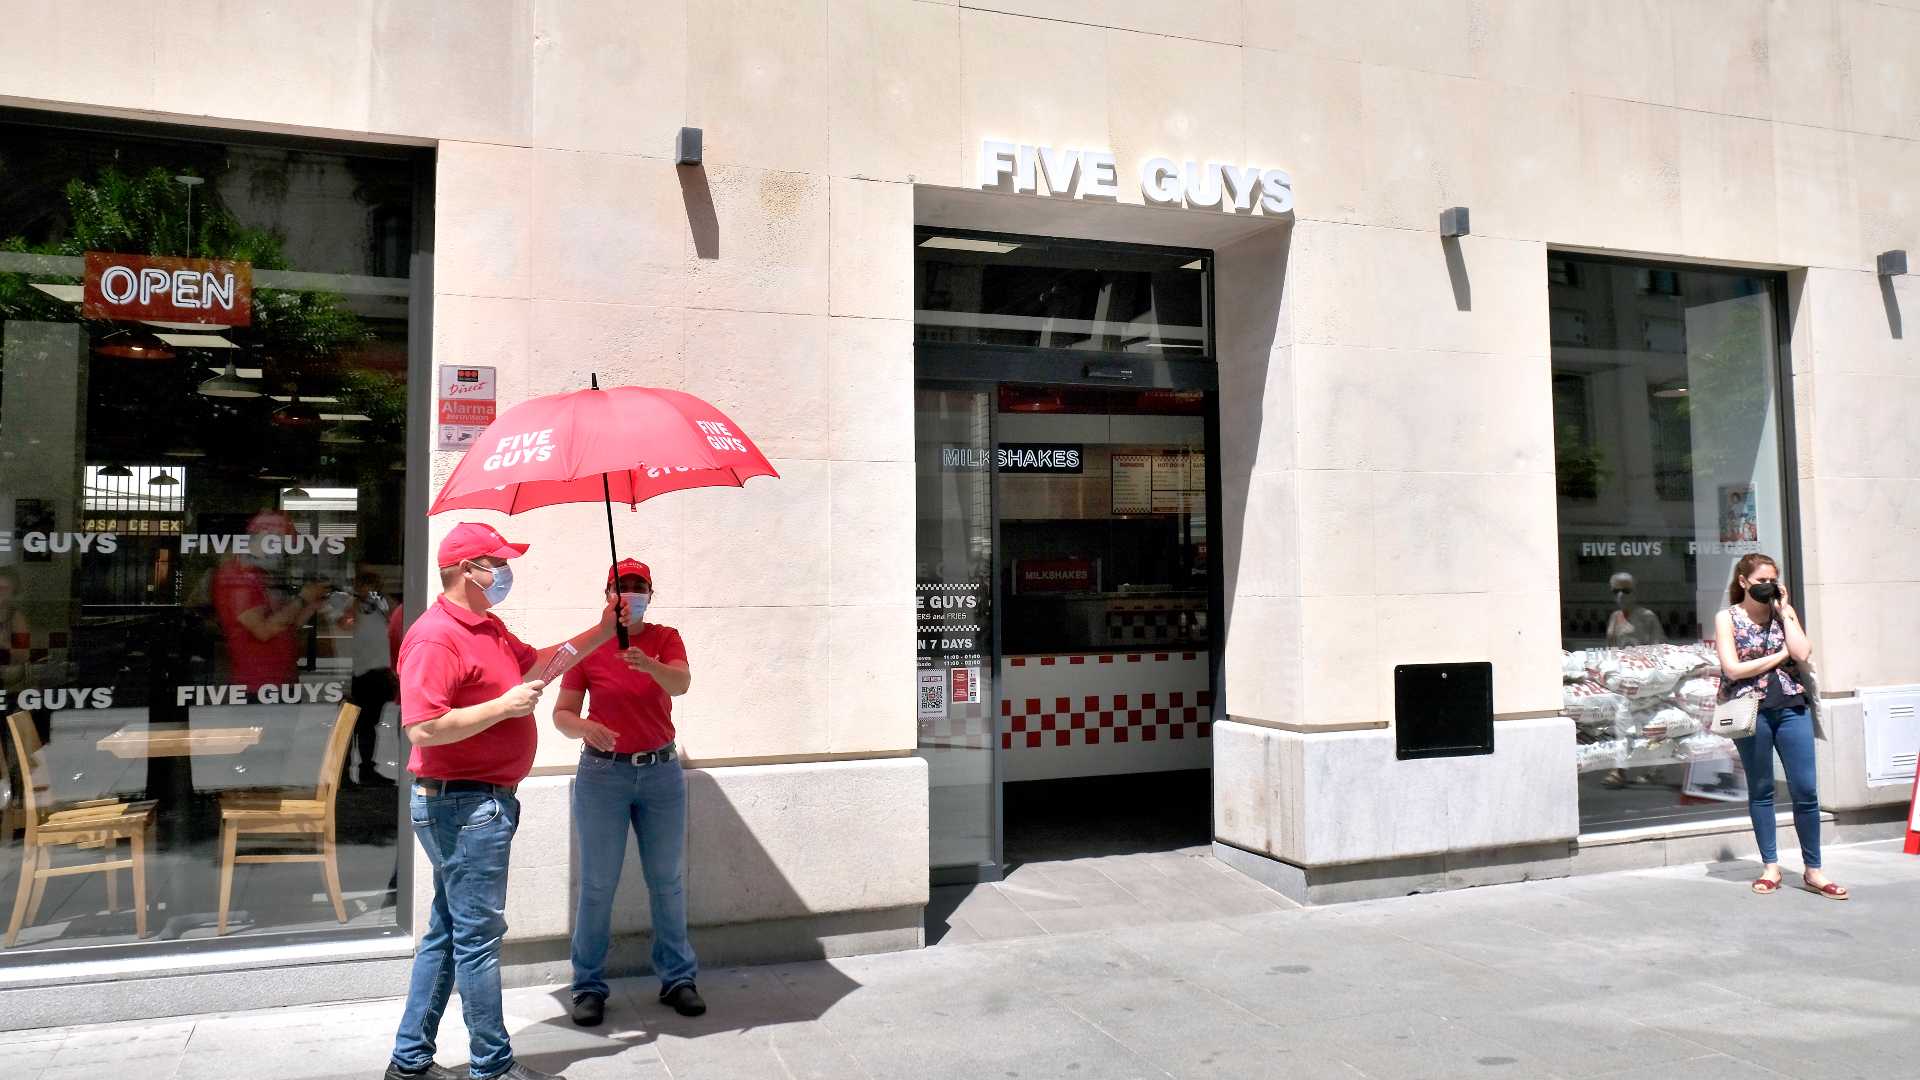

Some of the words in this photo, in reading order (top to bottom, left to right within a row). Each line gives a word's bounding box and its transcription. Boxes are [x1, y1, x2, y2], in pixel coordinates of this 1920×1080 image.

[983, 140, 1118, 200] FIVE
[1141, 157, 1294, 214] GUYS
[100, 265, 234, 310] OPEN
[441, 401, 494, 414] Alarma
[696, 420, 731, 438] FIVE
[496, 429, 553, 452] FIVE
[706, 435, 747, 453] GUYS
[483, 446, 552, 471] GUYS
[23, 531, 118, 554] GUYS
[180, 534, 252, 554] FIVE
[260, 533, 346, 555] GUYS
[1582, 542, 1617, 556] FIVE
[1621, 541, 1663, 556] GUYS
[1688, 541, 1721, 555] FIVE
[1025, 570, 1088, 580] MILKSHAKES
[930, 595, 977, 609] GUYS
[946, 612, 967, 620] FRIES
[930, 639, 938, 650] 7
[941, 639, 973, 649] DAYS
[17, 687, 113, 711] GUYS
[176, 685, 247, 707] FIVE
[257, 682, 343, 705] GUYS
